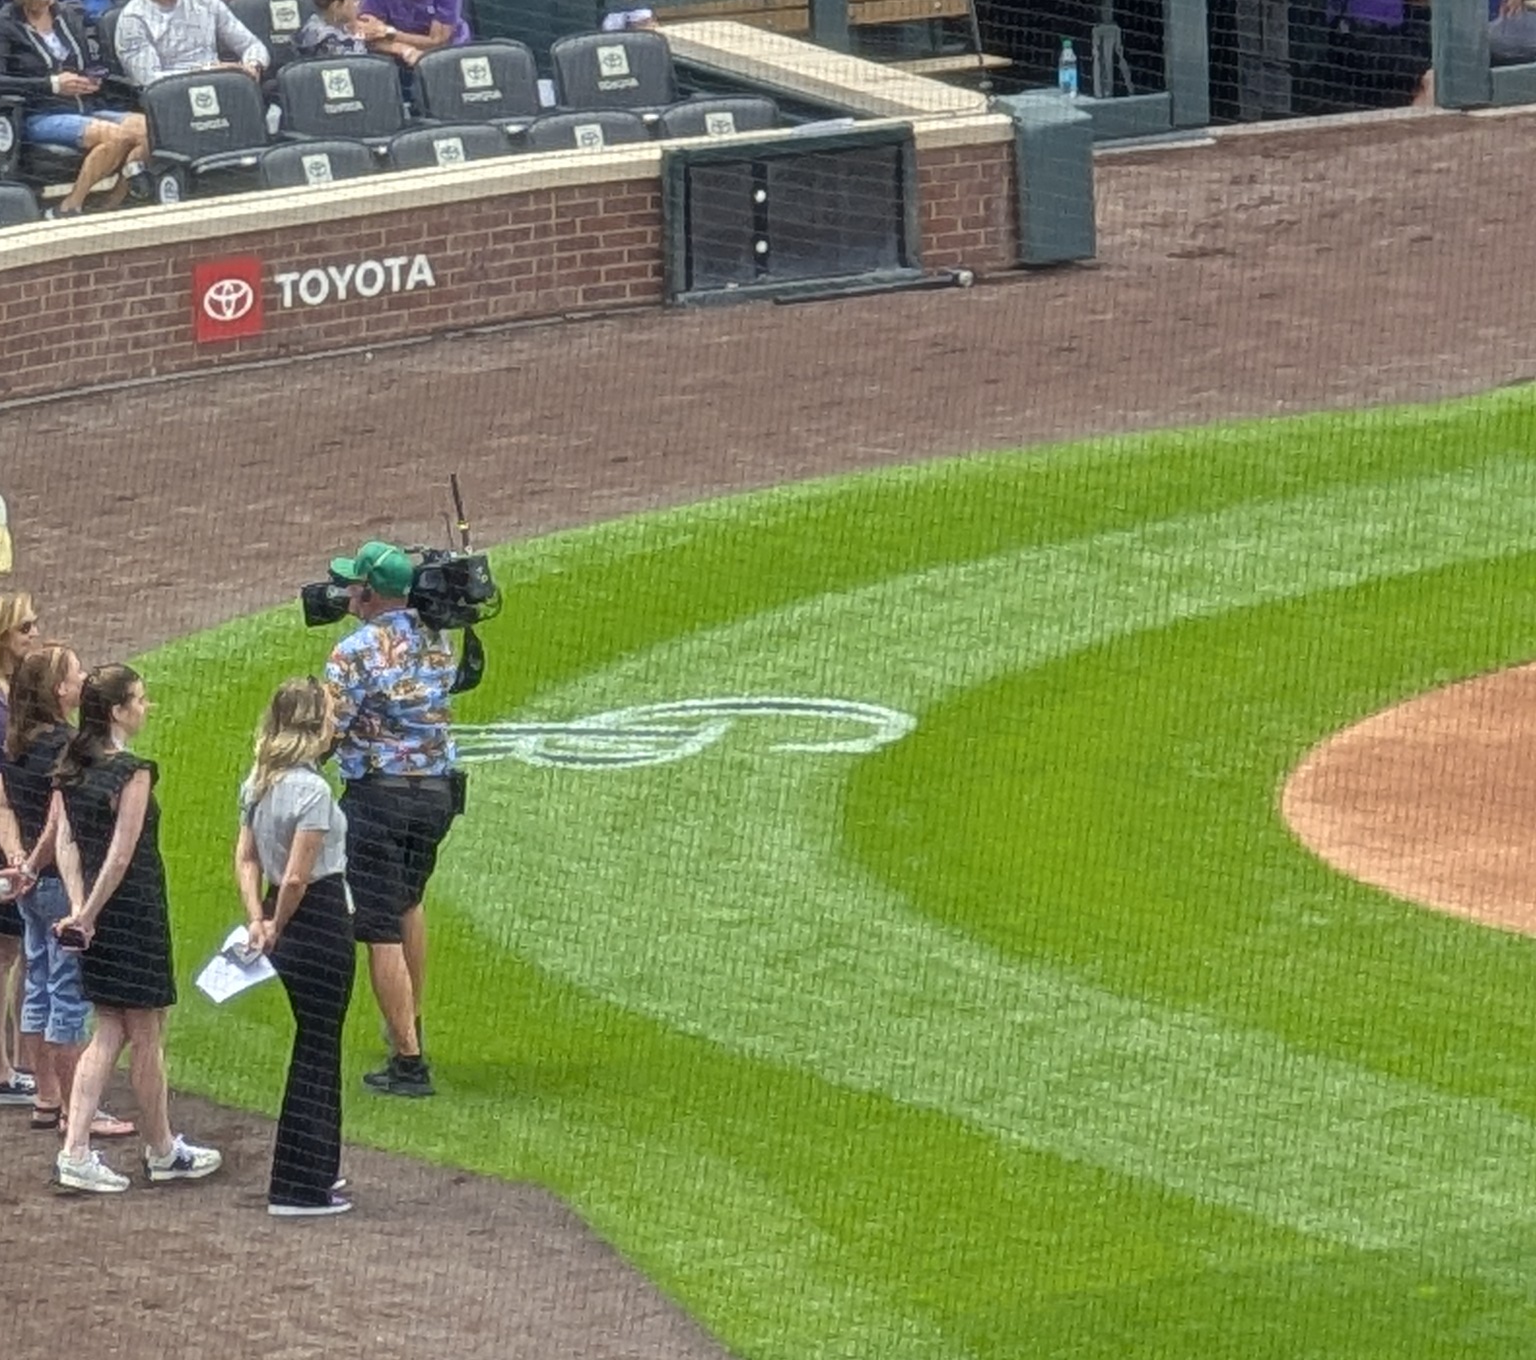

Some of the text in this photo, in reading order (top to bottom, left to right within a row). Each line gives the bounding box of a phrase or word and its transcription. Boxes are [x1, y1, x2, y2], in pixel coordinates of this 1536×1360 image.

[597, 76, 639, 92] TOYOTA
[461, 89, 503, 104] TOYOTA
[323, 100, 364, 116] TOYOTA
[190, 117, 230, 133] TOYOTA
[275, 254, 436, 308] TOYOTA
